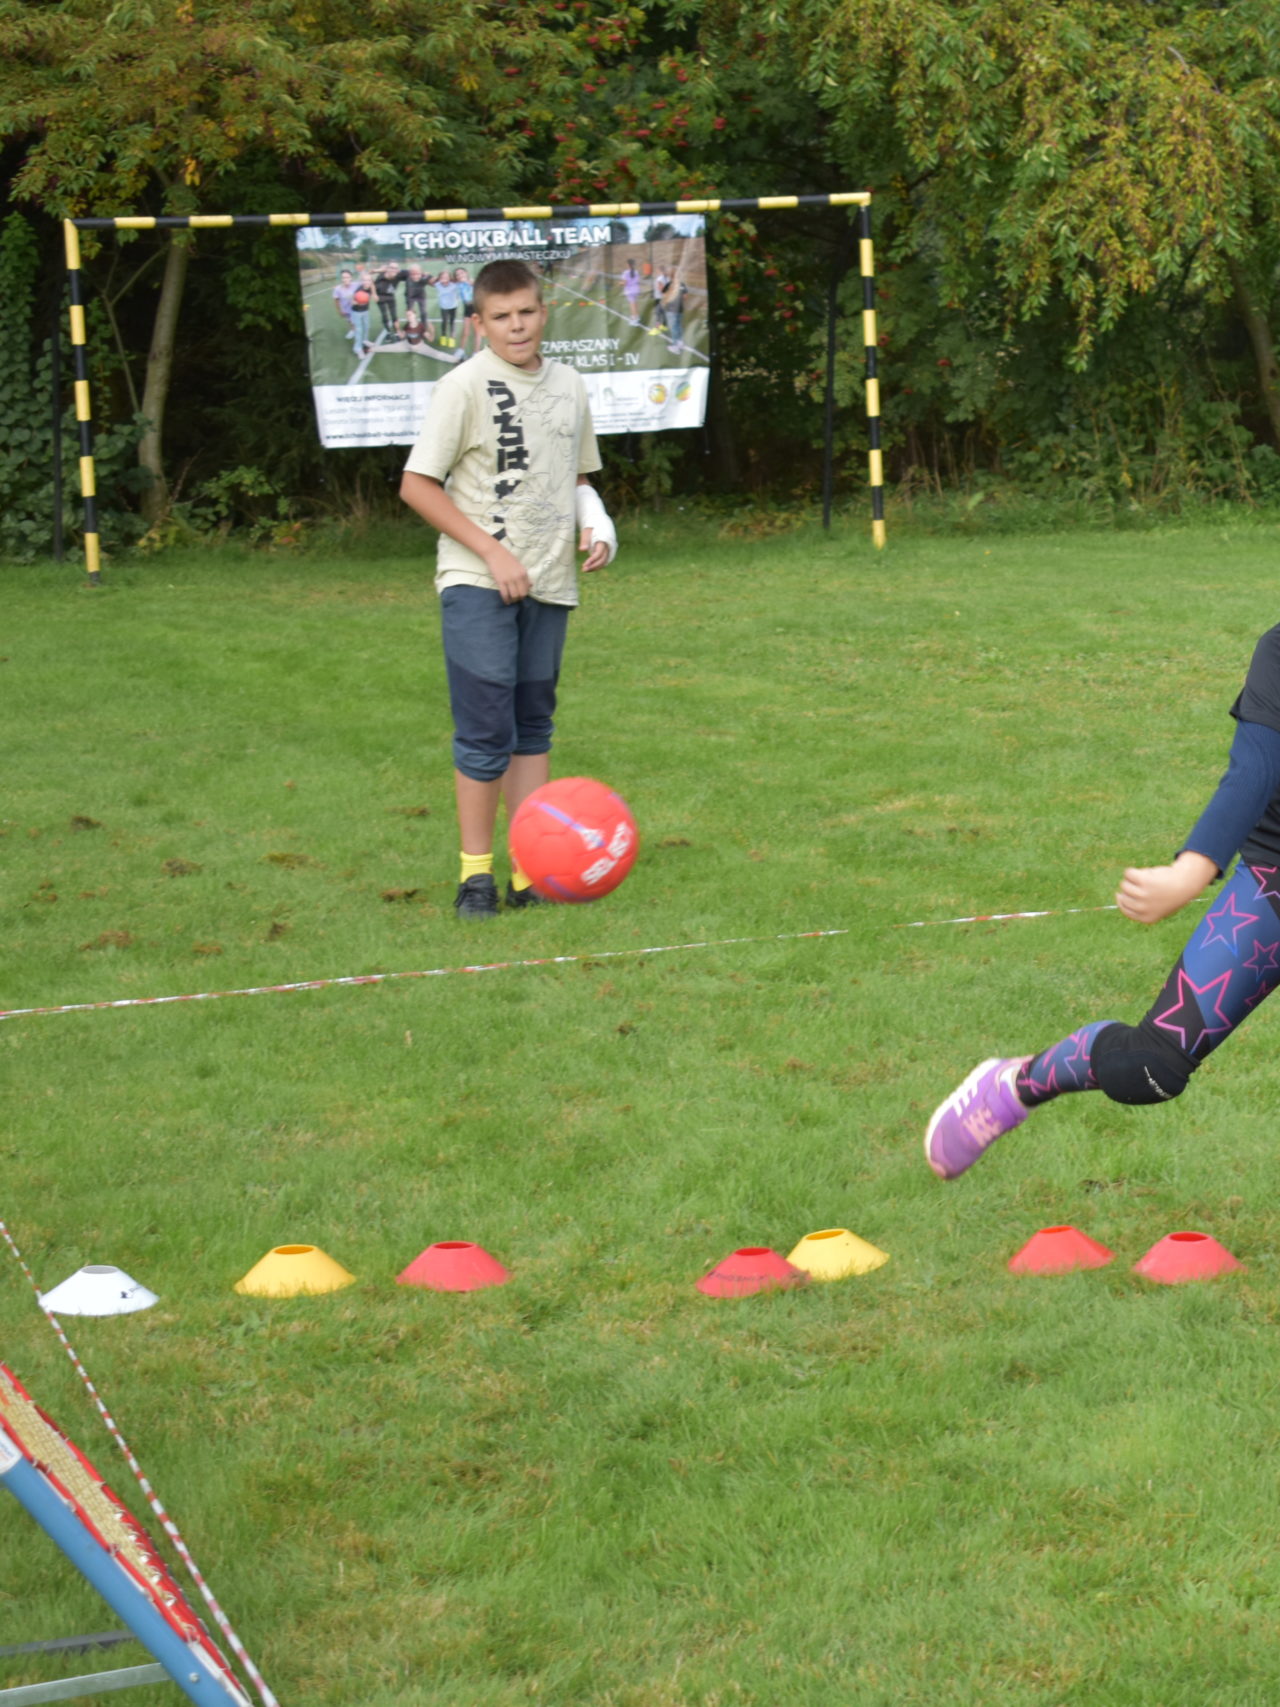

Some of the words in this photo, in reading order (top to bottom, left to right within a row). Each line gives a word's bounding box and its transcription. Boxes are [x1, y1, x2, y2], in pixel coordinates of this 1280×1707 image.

[400, 228, 548, 250] TCHOUKBALL
[551, 226, 612, 245] TEAM
[504, 249, 571, 261] MIASTECZKU
[541, 338, 620, 353] ZAPRASZAMY
[575, 354, 608, 367] KLAS
